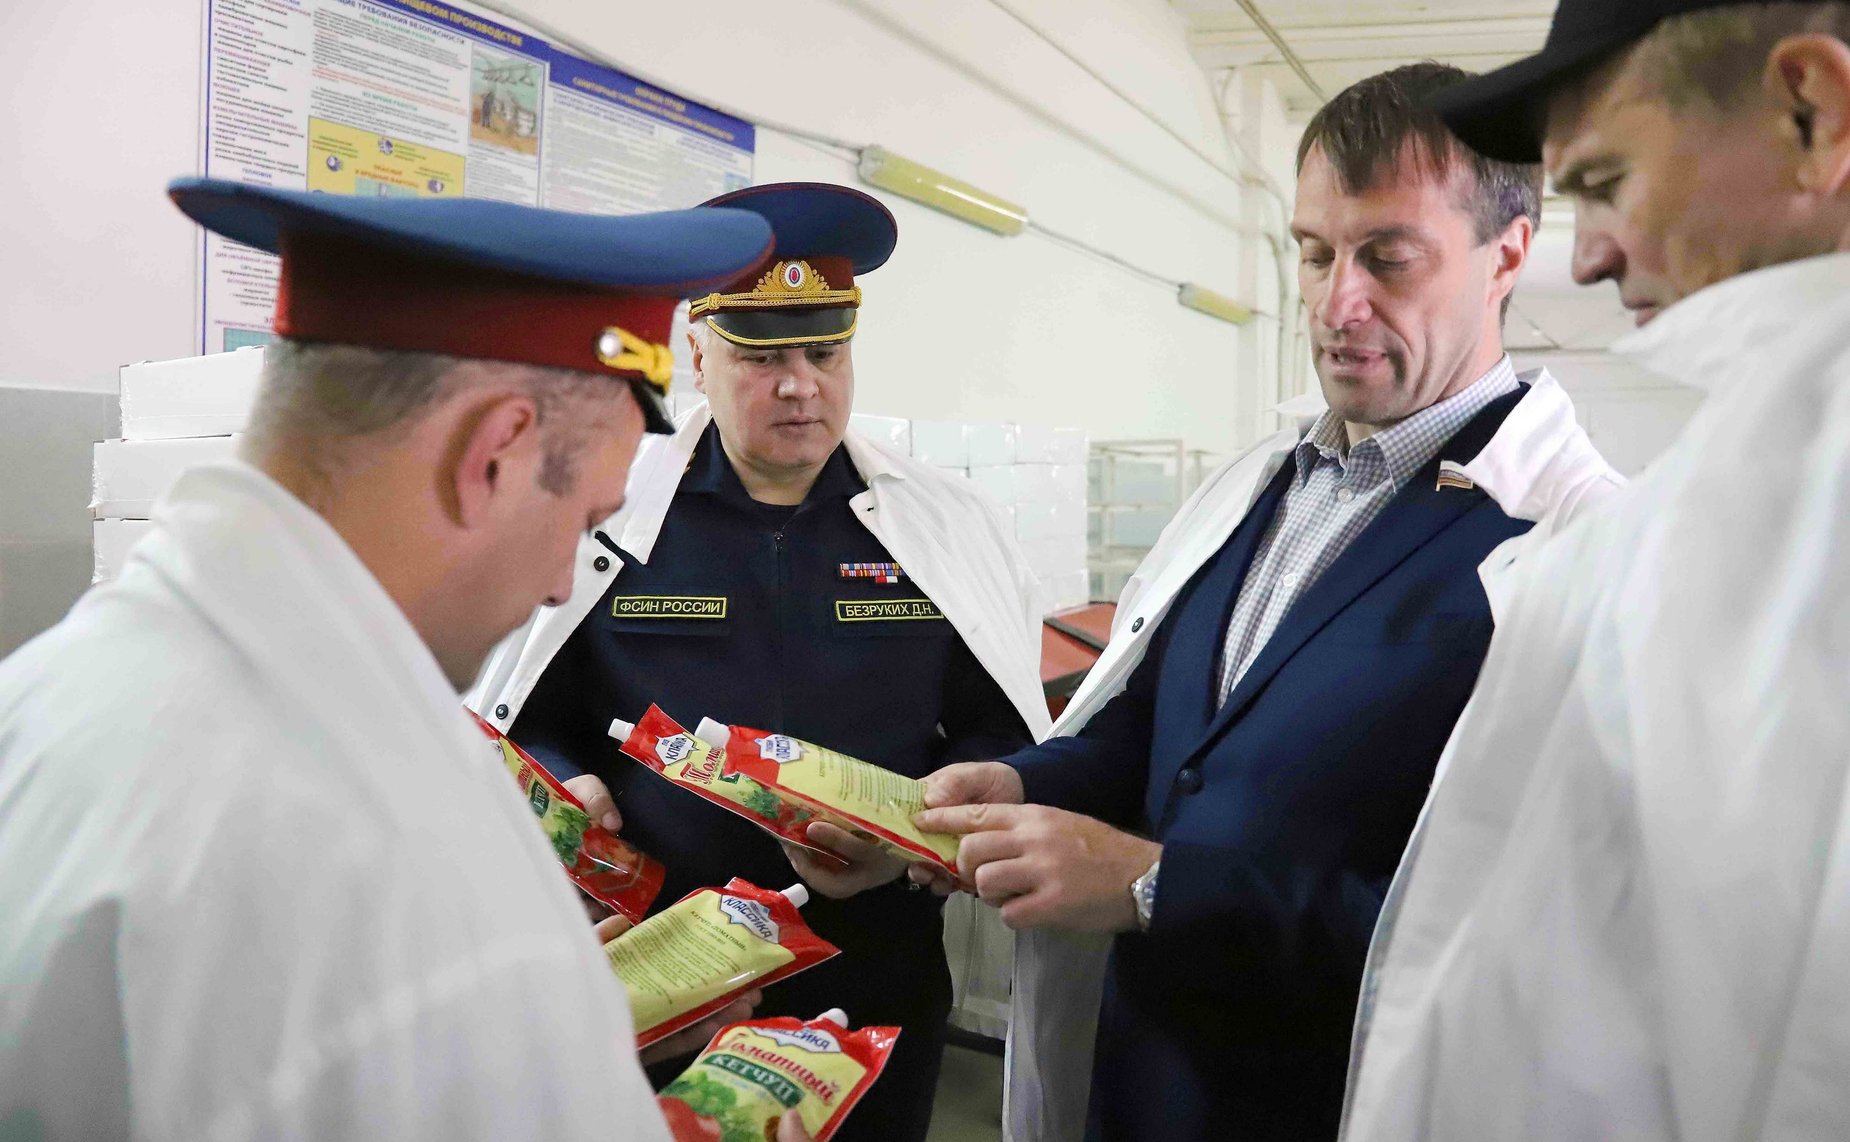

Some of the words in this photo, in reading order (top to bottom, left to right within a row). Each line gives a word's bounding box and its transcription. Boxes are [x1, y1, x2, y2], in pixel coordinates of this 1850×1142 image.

[620, 601, 660, 613] ФСИН
[662, 601, 720, 613] РОССИИ
[845, 603, 910, 617] БЕЗРУКИХ
[912, 603, 935, 616] Д.Н.
[723, 897, 773, 938] КЛАССИКА
[711, 1055, 795, 1102] КЕТЧУП
